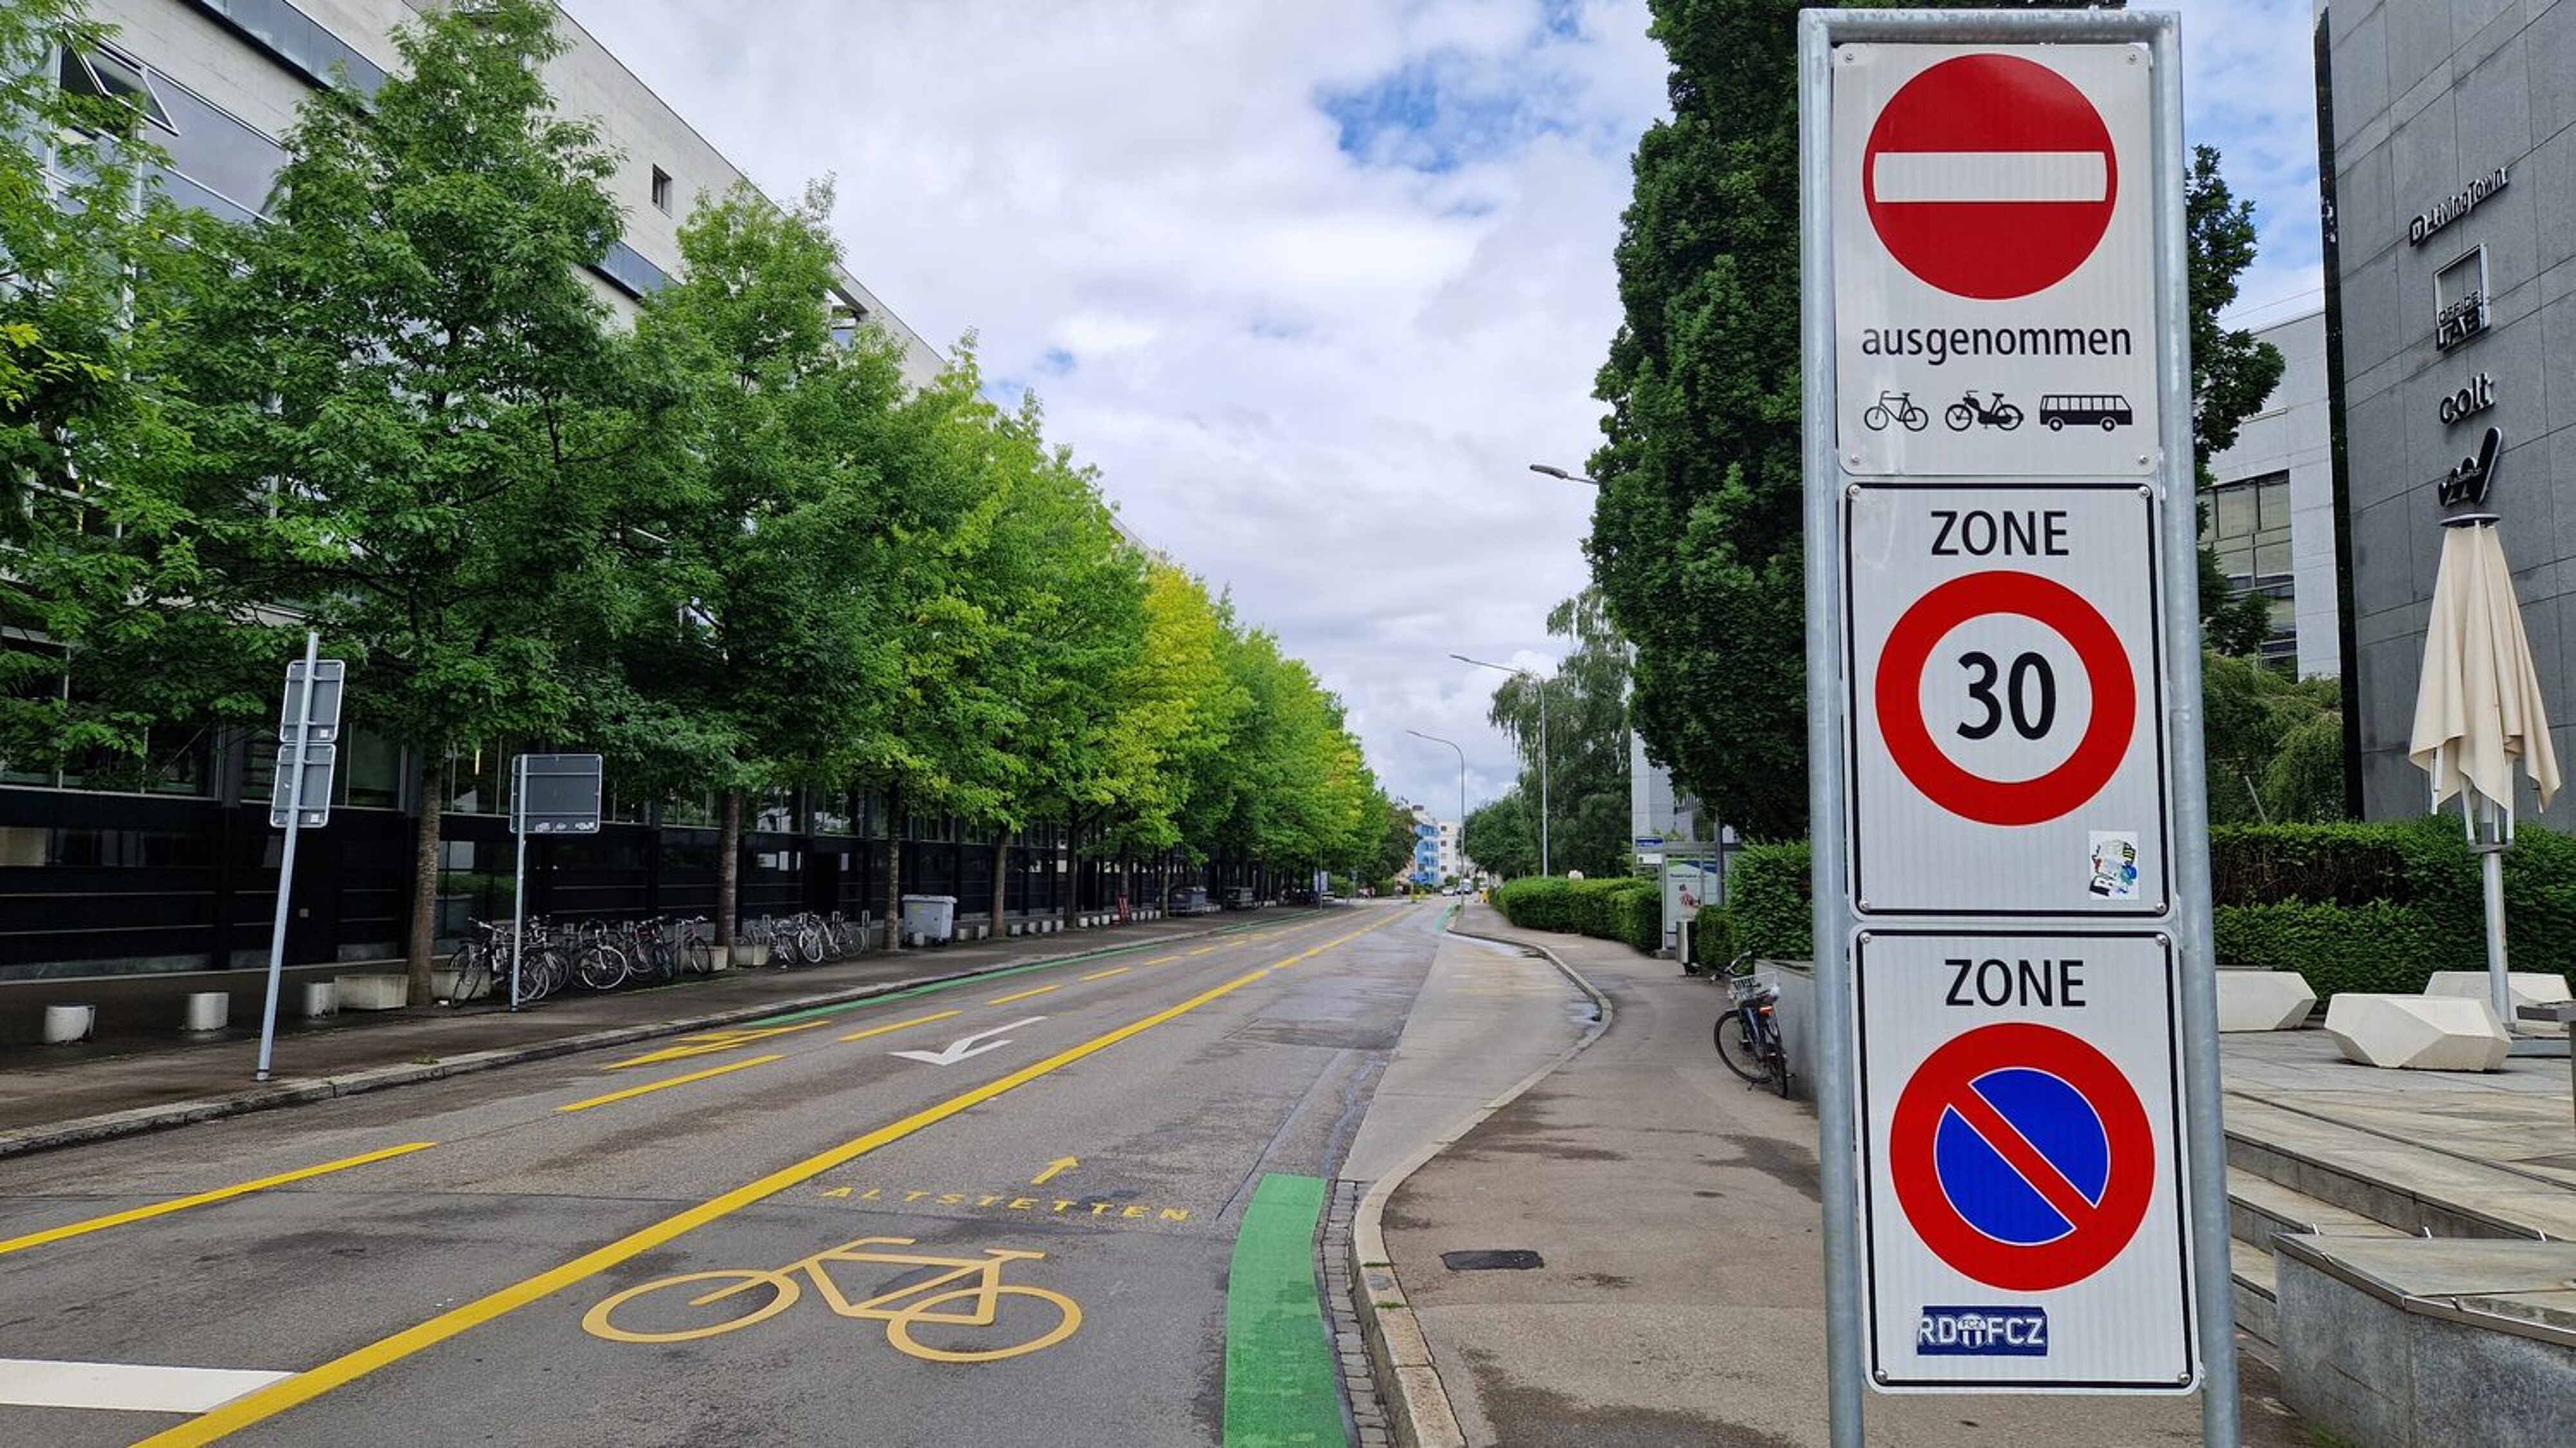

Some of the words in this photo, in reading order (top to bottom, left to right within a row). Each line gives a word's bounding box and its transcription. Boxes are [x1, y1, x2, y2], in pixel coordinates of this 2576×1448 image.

[2438, 290, 2482, 323] OFFICE
[1862, 327, 2132, 365] ausgenommen
[2436, 307, 2484, 352] LAB
[2439, 372, 2495, 425] colt
[1931, 510, 2069, 557] ZONE
[1956, 651, 2056, 741] 30
[1944, 958, 2086, 1007] ZONE
[820, 1186, 1193, 1223] ALTSTETTEN
[1962, 1319, 1981, 1329] FCZ
[1987, 1316, 2045, 1344] FCZ
